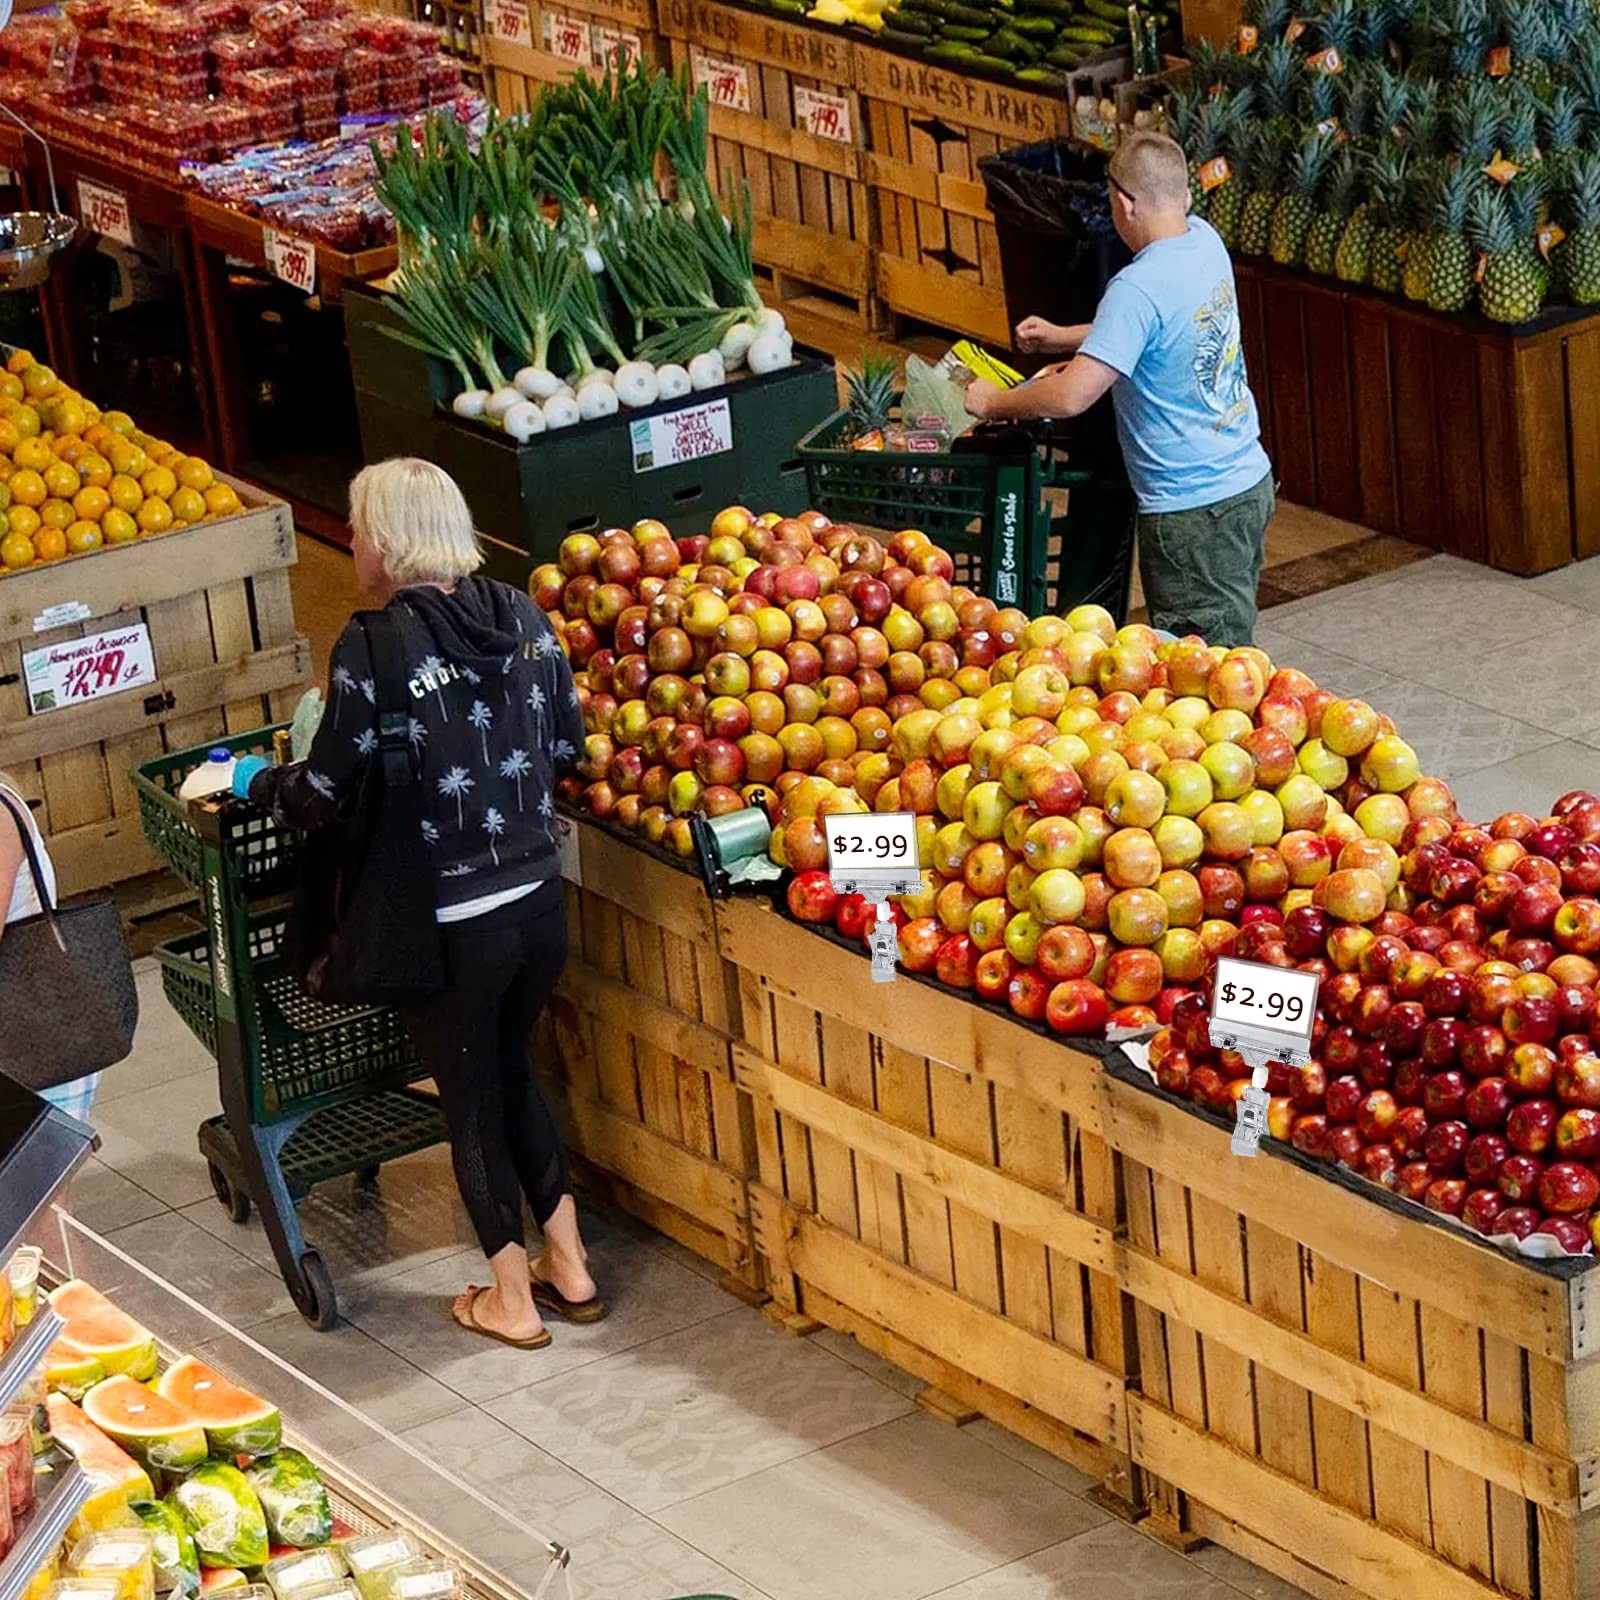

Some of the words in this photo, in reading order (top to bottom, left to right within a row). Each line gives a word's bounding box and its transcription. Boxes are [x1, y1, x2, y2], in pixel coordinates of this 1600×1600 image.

[670, 1, 740, 43] OAKES
[764, 26, 838, 71] FARMS
[675, 427, 715, 448] ONIONS
[676, 416, 708, 436] SWEET
[695, 438, 724, 456] EACH
[1000, 491, 1018, 525] Table
[1001, 525, 1015, 538] to
[1001, 538, 1016, 571] Seed
[833, 834, 908, 859] $2.99
[1220, 981, 1304, 1022] $2.99
